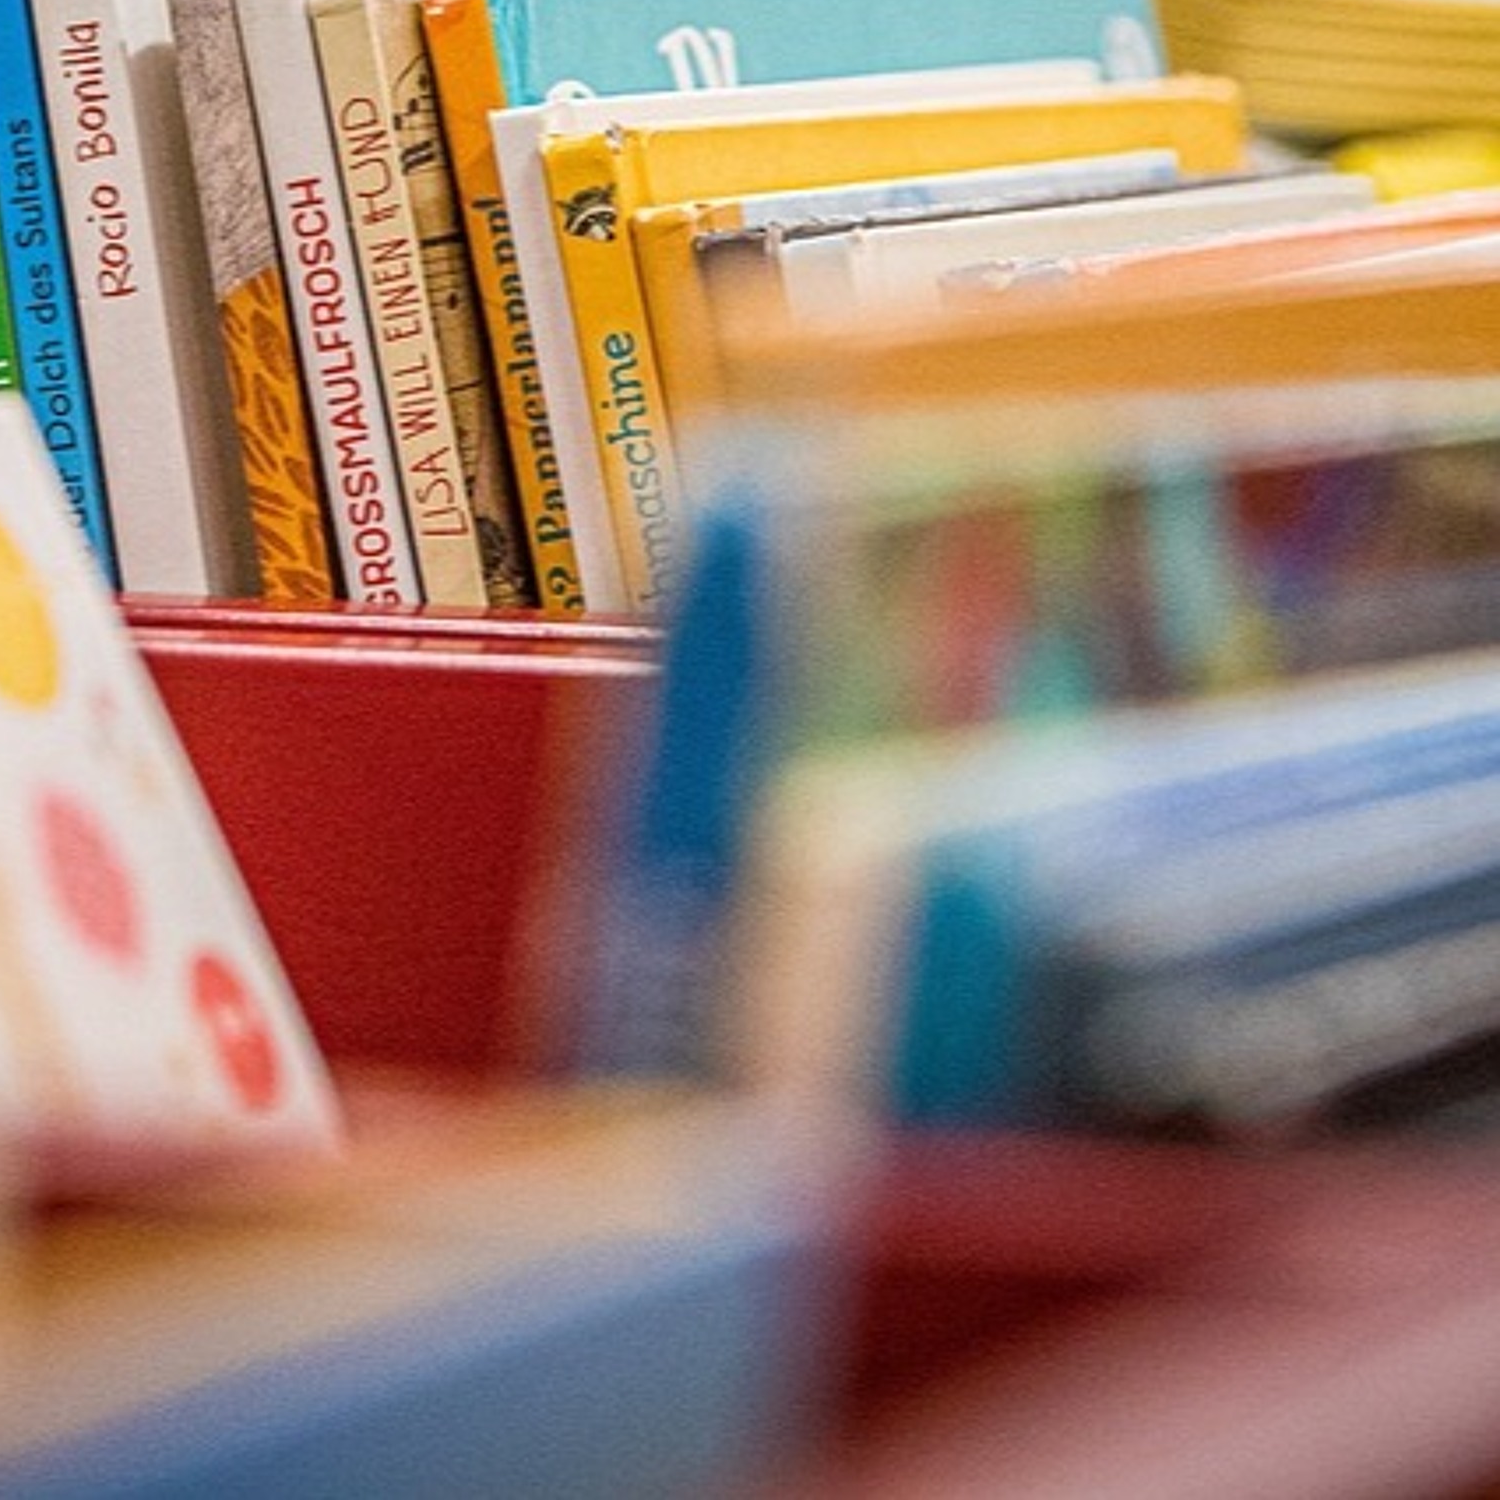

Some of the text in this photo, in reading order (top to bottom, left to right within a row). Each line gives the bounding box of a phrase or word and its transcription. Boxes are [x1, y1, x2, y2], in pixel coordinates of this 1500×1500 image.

[62, 20, 118, 163] Bonilla
[8, 118, 51, 249] Sultans
[25, 263, 62, 325] des
[340, 96, 470, 537] LISA WILL EINEN HUND
[32, 339, 79, 452] Dolch
